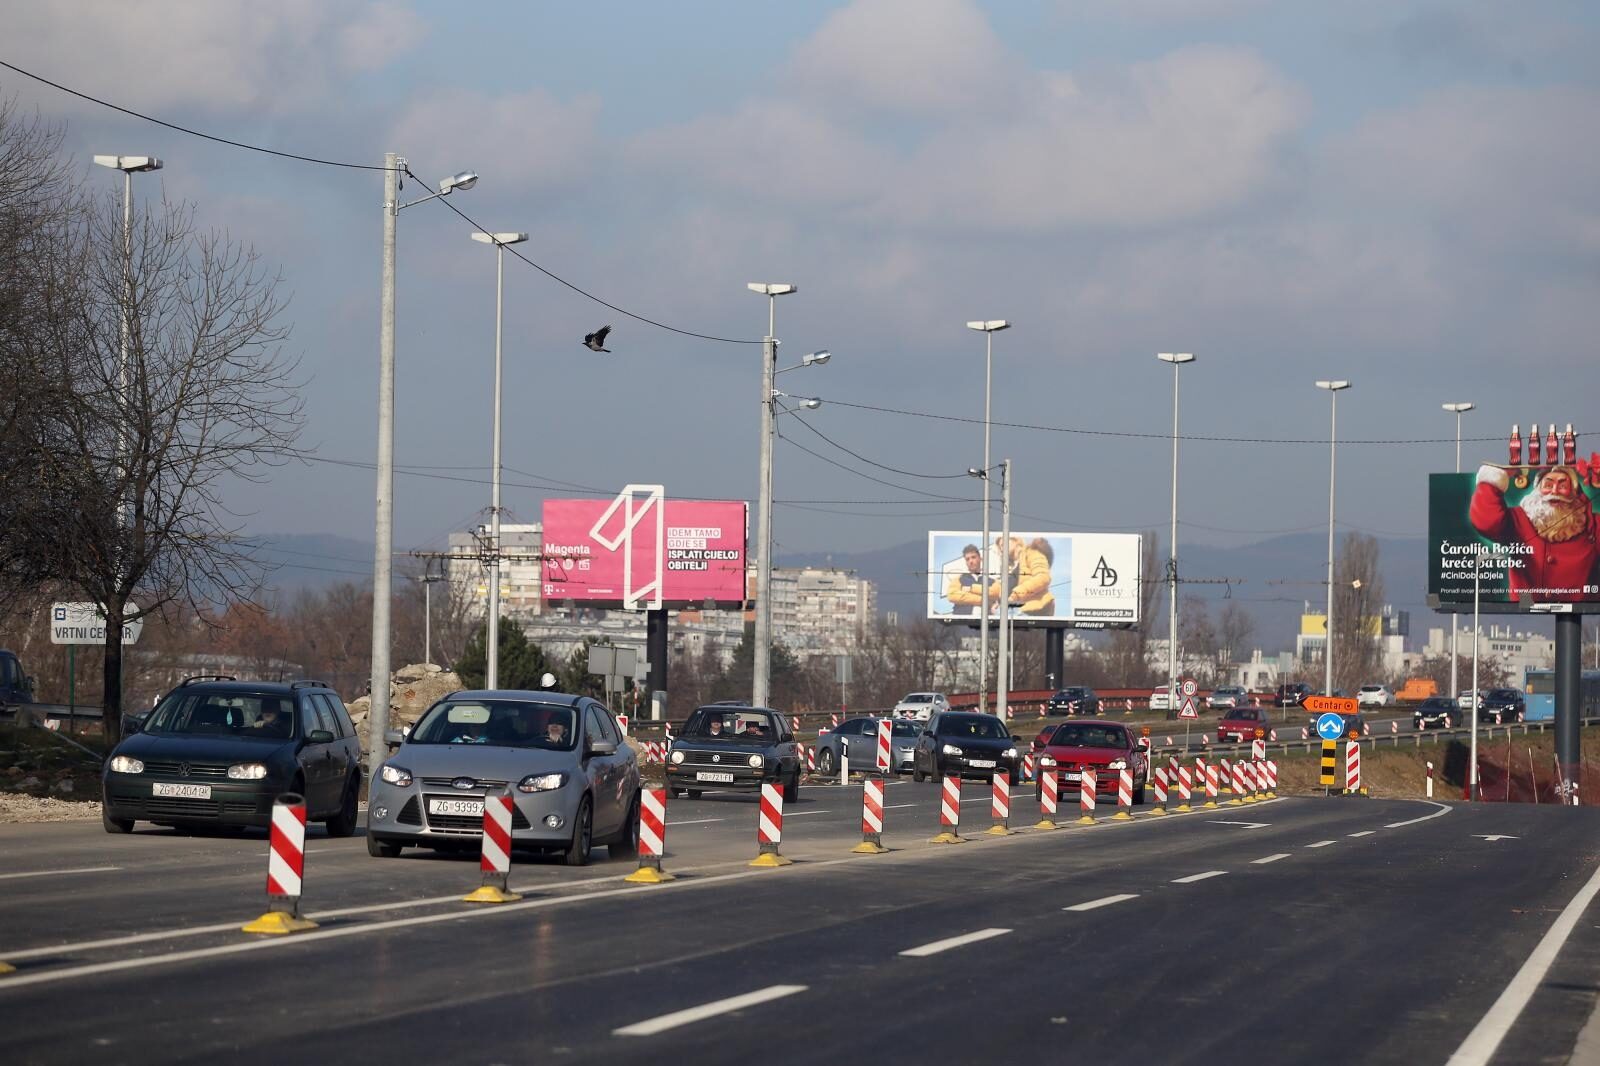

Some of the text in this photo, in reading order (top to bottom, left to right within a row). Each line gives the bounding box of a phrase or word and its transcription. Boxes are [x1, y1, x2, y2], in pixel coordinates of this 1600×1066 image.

[668, 528, 720, 537] IDEM TAMO
[693, 539, 705, 548] SE
[1440, 540, 1534, 557] Čarolija Božića
[545, 543, 590, 556] Magenta
[668, 550, 739, 560] ISPLATI CIJELOJ
[668, 561, 708, 570] OBITELJI
[1441, 556, 1474, 569] kreće
[1084, 587, 1123, 599] twenty
[55, 627, 87, 639] VRTNI
[1313, 700, 1342, 710] Centar
[437, 801, 448, 812] ZG
